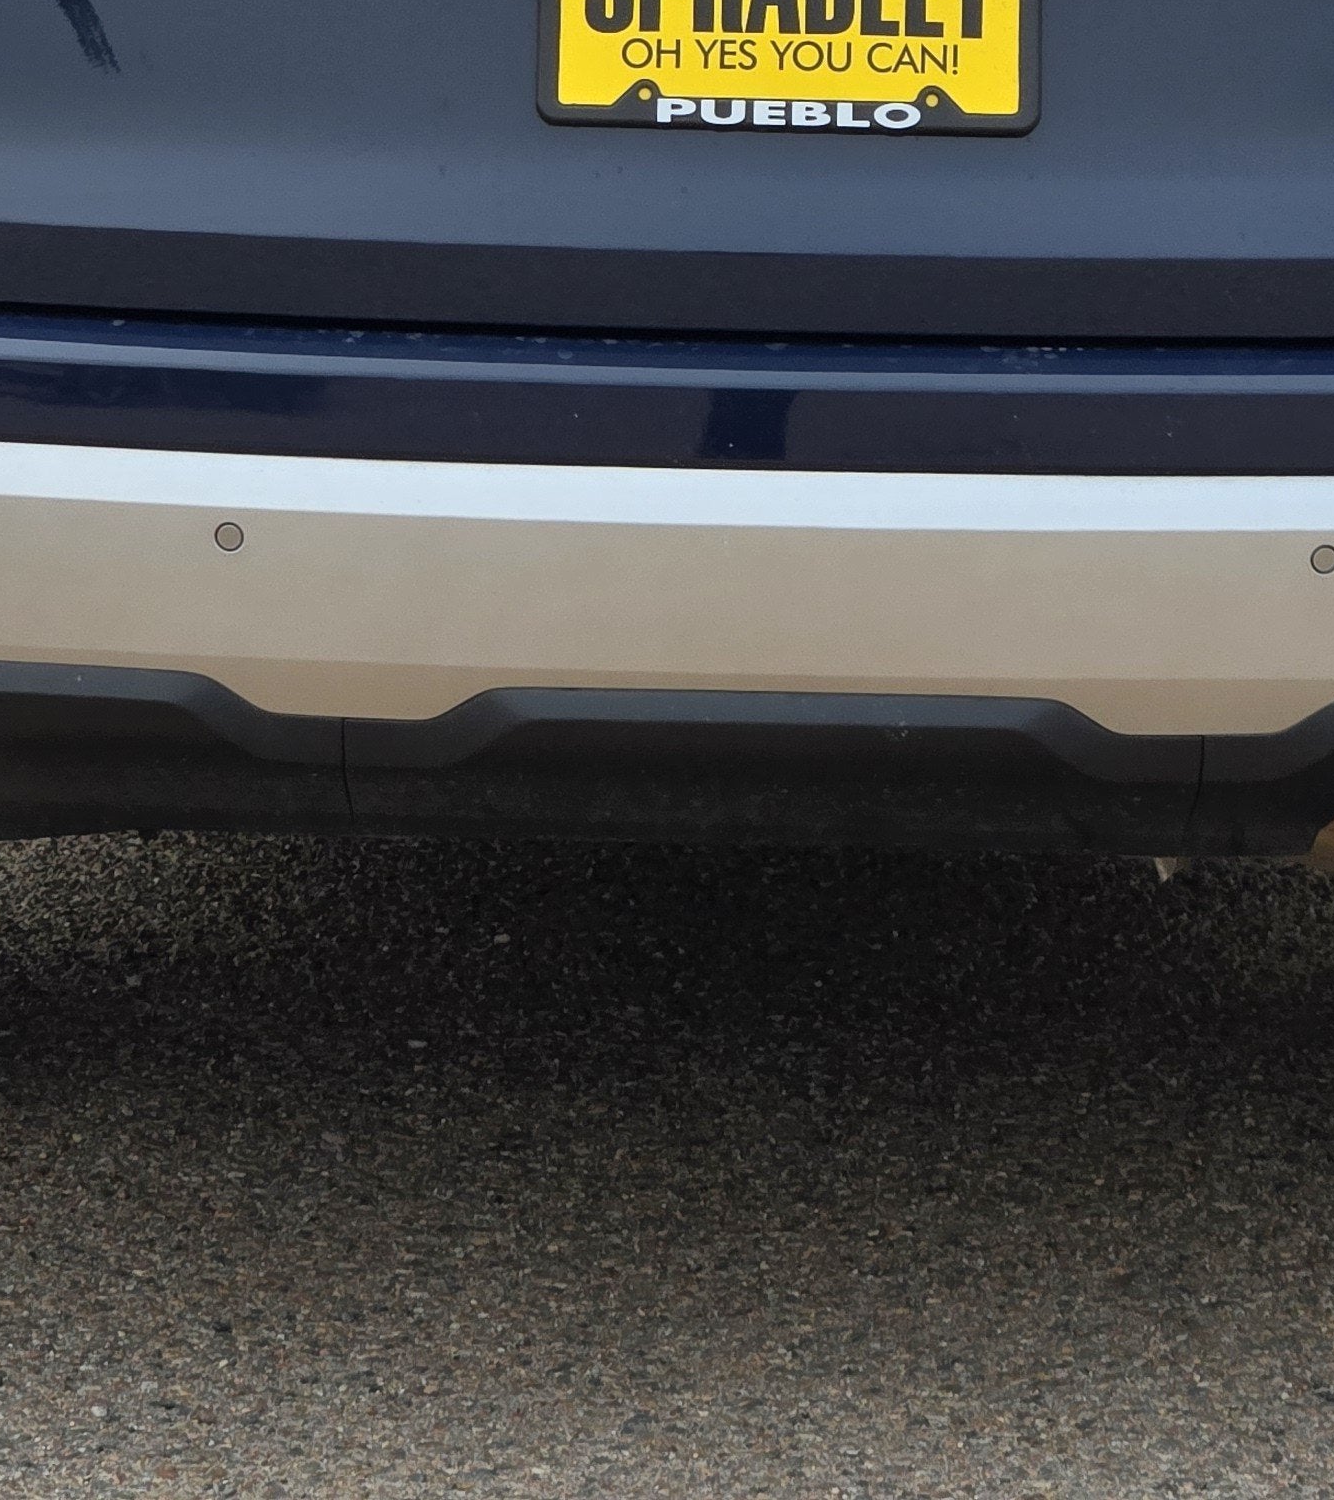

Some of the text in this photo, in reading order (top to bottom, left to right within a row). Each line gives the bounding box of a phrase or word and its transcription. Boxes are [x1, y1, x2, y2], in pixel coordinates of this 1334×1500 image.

[621, 38, 959, 75] OH YES YOU CAN!
[656, 98, 922, 129] PUEBLO
